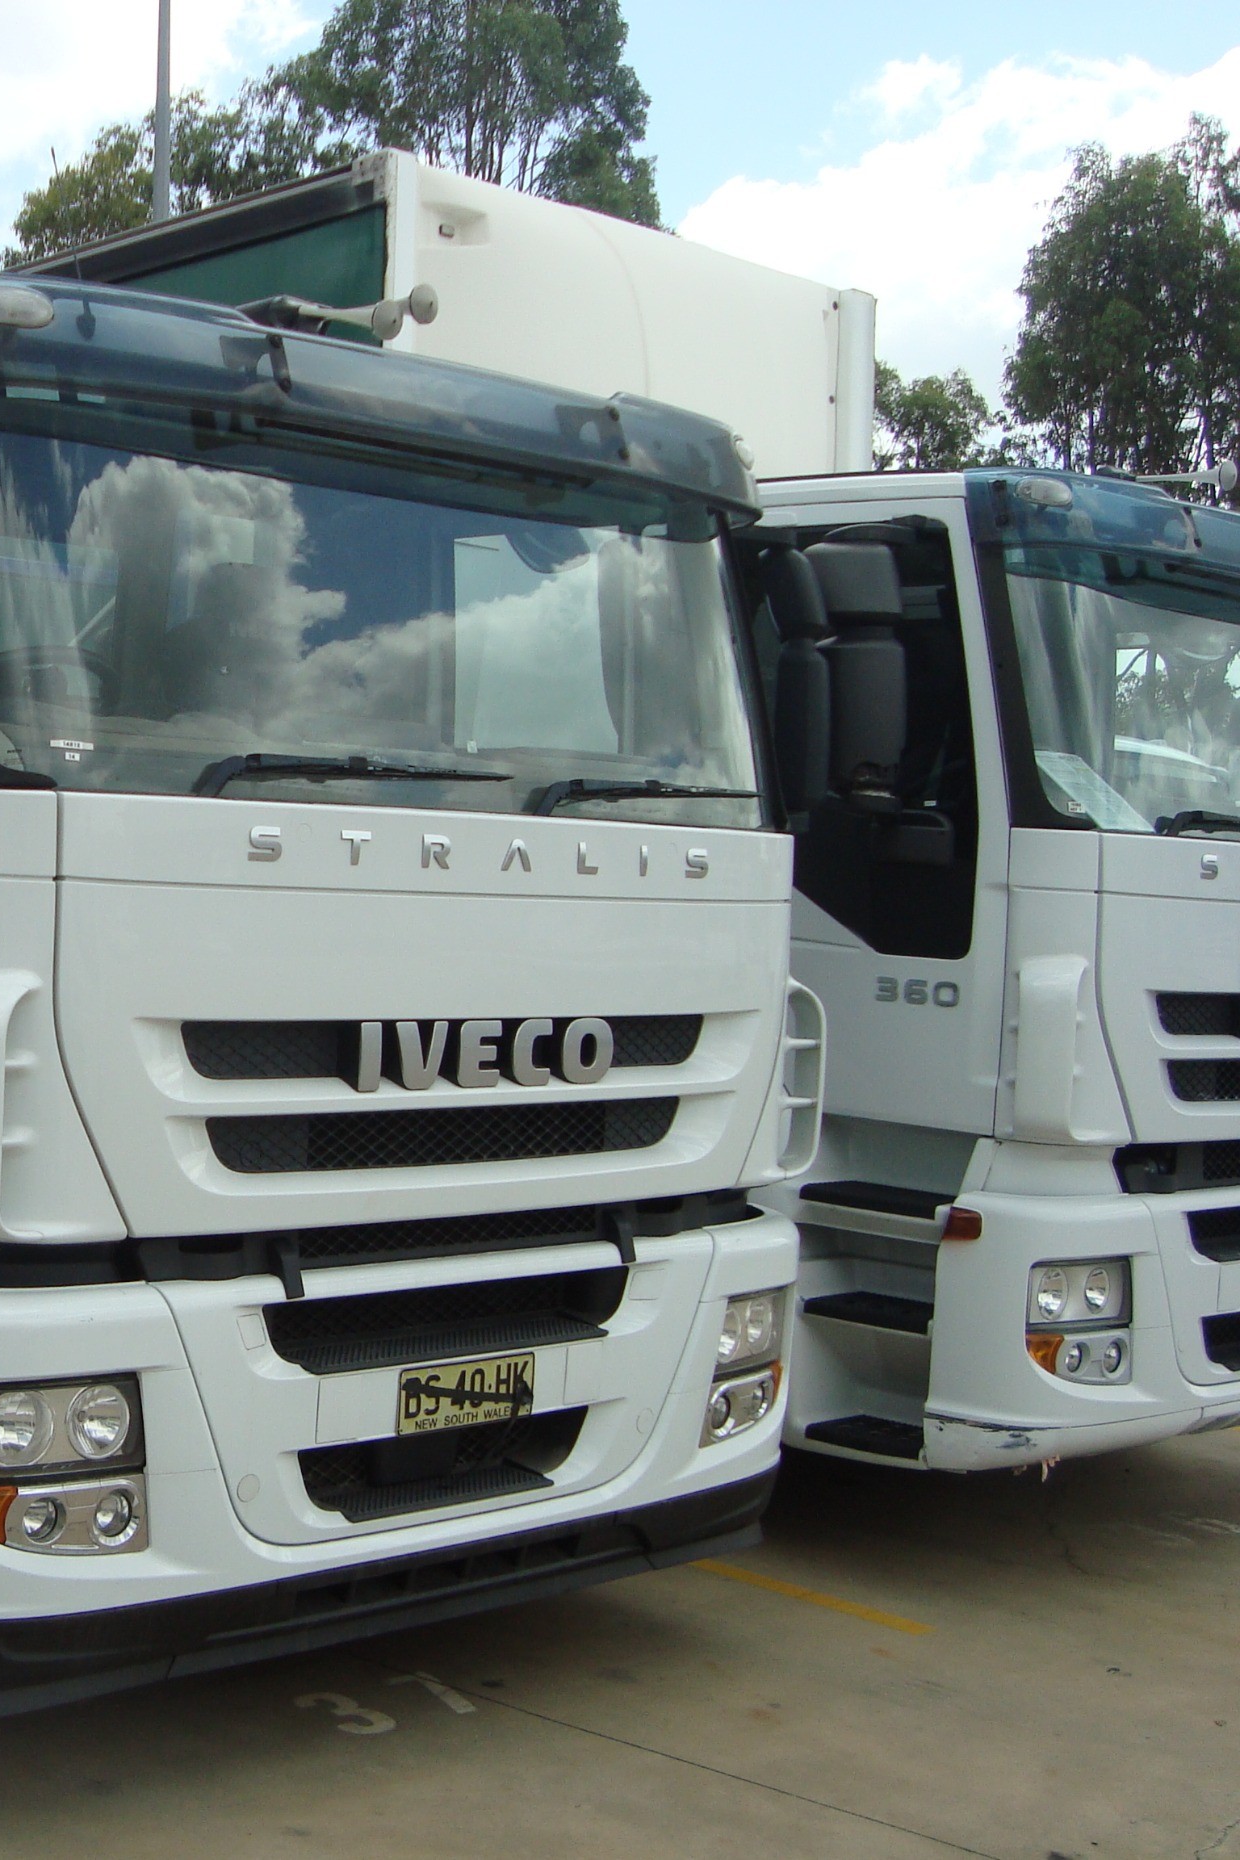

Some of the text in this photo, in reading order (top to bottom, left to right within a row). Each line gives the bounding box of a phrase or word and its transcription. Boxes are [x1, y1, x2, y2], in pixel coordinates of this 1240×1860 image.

[247, 825, 710, 879] STRALIS
[875, 976, 960, 1008] 360
[358, 1017, 615, 1093] IVECO
[414, 1405, 513, 1431] NEW SOUTH WALE
